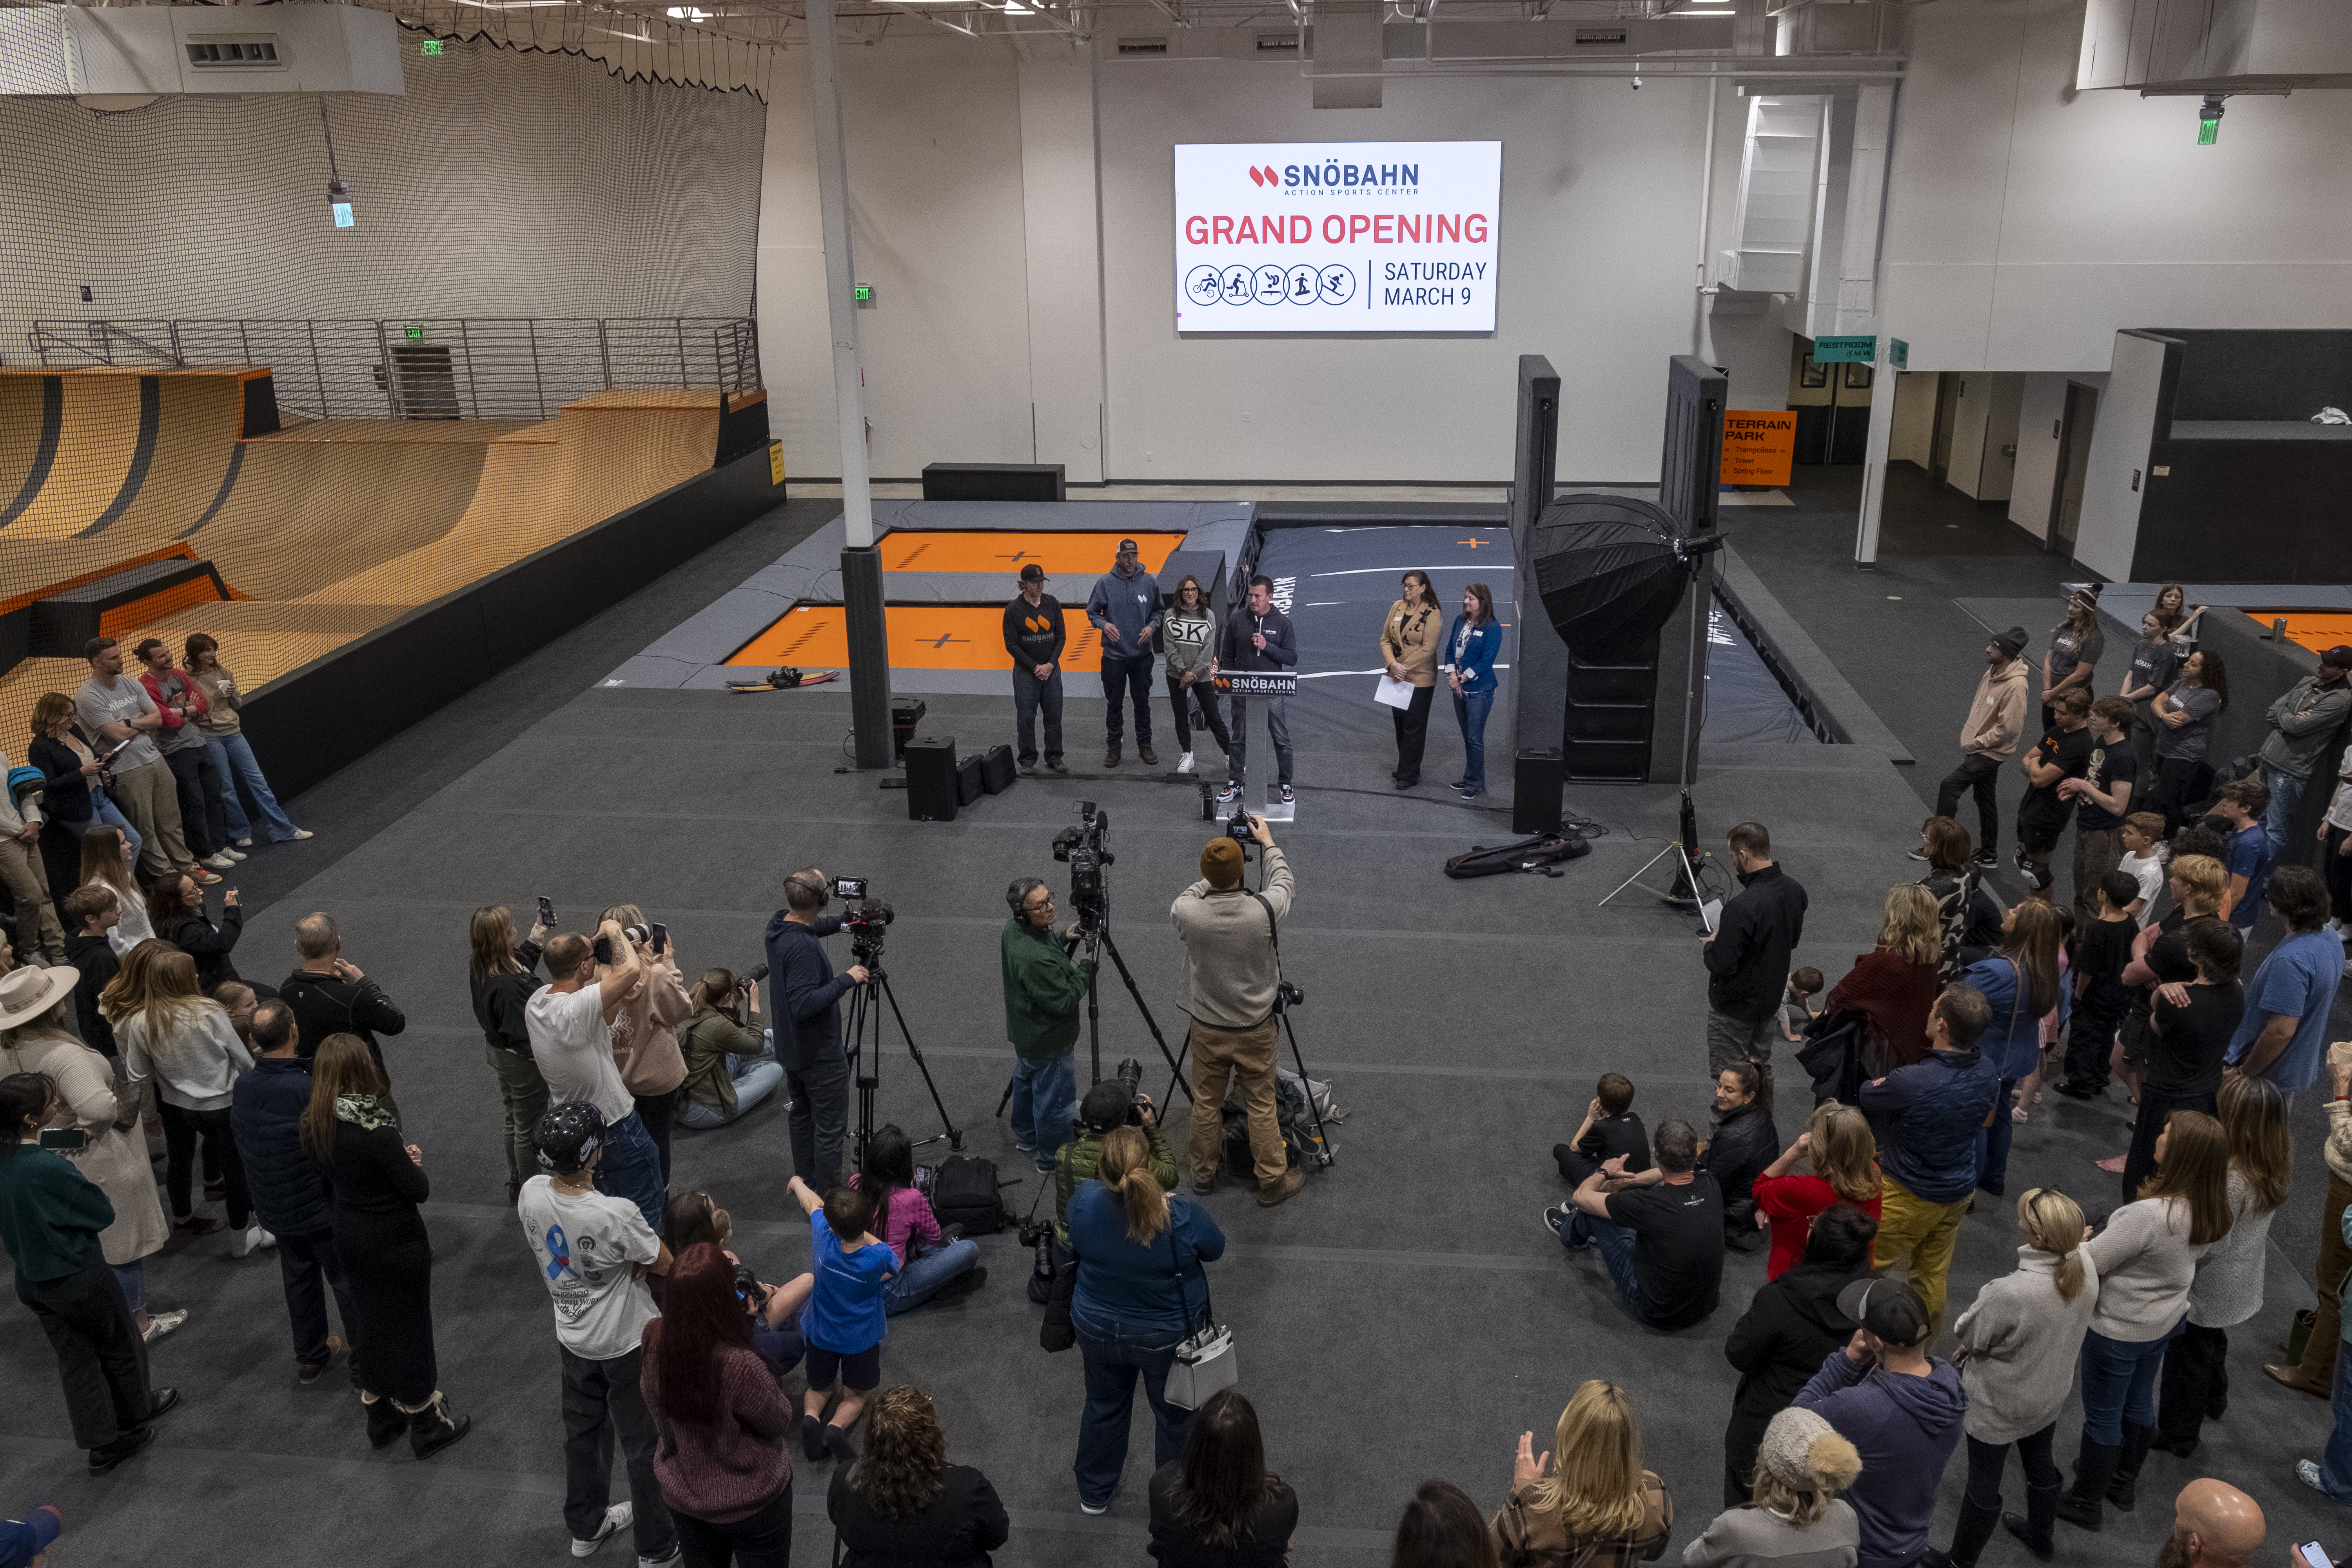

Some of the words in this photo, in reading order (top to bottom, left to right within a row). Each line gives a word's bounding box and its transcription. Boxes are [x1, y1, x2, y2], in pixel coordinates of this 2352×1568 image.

[2200, 120, 2217, 144] EXIT
[1284, 158, 1419, 187] SNÖBAHN
[1186, 215, 1312, 245] GRAND
[1323, 214, 1488, 243] OPENING
[1385, 262, 1487, 280] SATURDAY
[855, 288, 869, 299] EXIT
[1385, 287, 1454, 305] MARCH
[1462, 288, 1471, 305] 9
[1727, 419, 1791, 430] TERRAIN
[1725, 431, 1765, 441] PARK
[1022, 632, 1054, 642] SNÖBAHN
[1171, 621, 1206, 642] SK
[1232, 677, 1296, 690] SNÖBAHN
[581, 1135, 593, 1155] NIKE
[592, 1138, 598, 1149] SB
